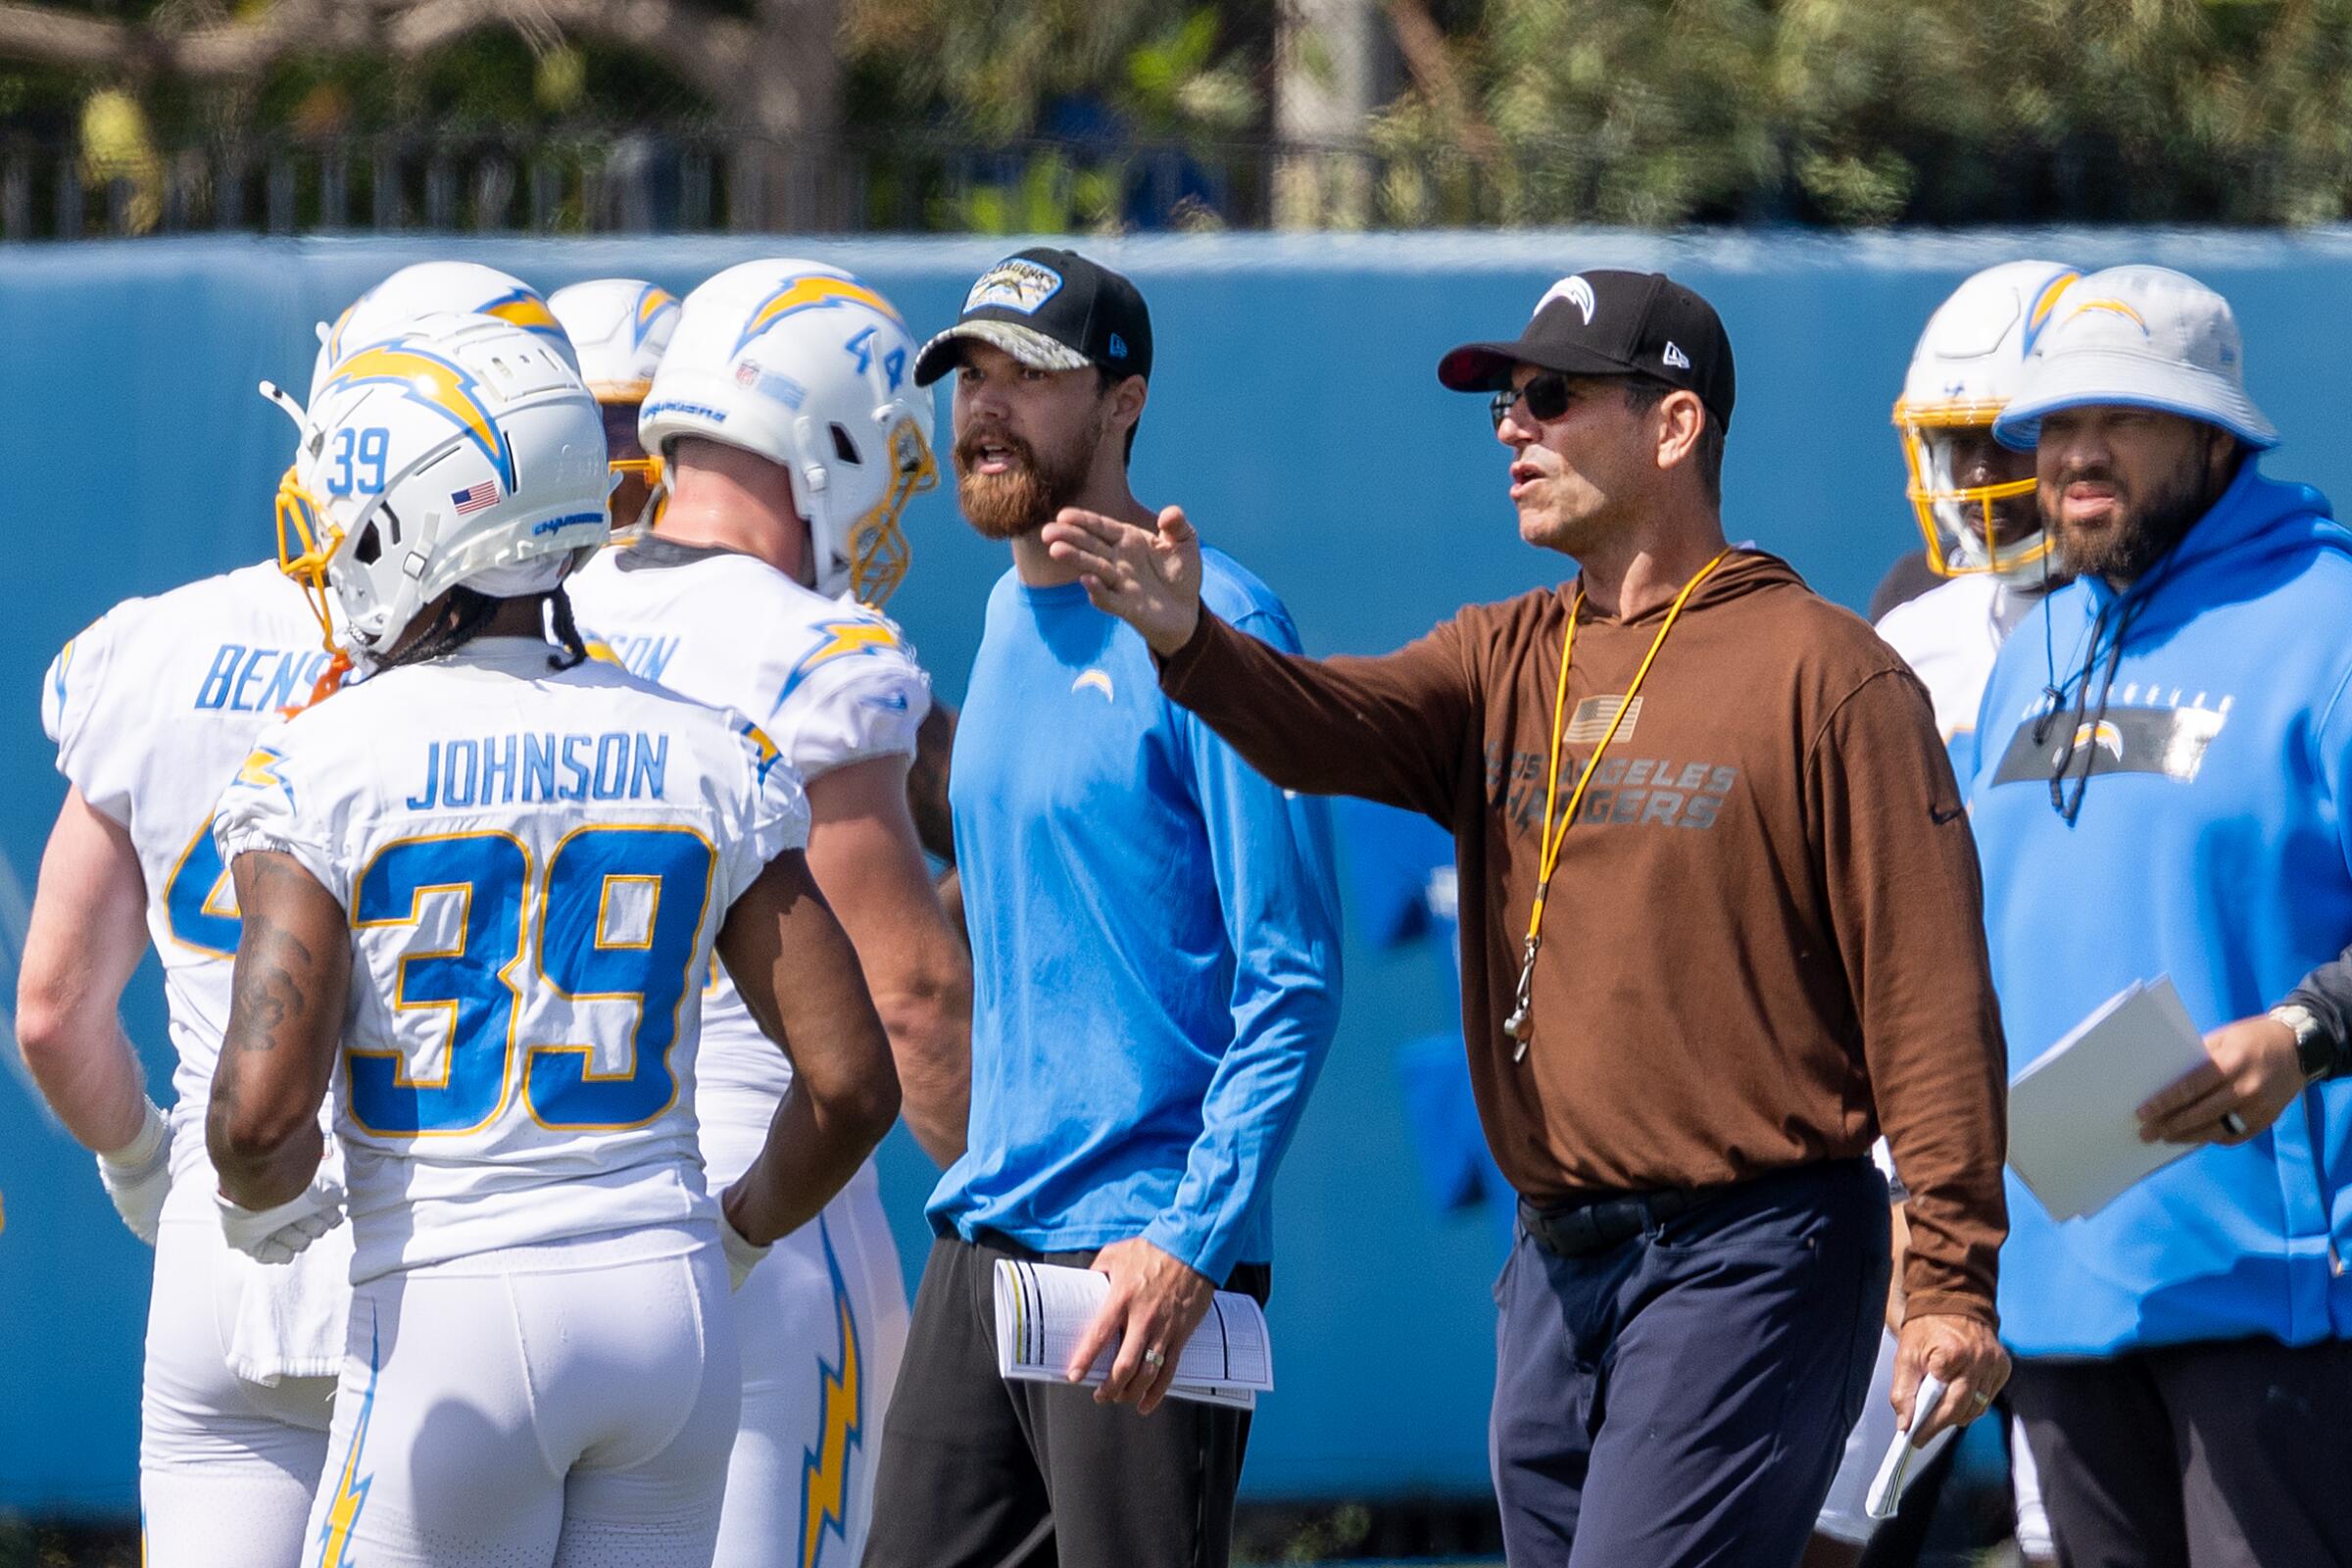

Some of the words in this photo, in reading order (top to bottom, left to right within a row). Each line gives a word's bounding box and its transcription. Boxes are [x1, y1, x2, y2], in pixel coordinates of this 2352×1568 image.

[845, 323, 906, 394] 44
[326, 427, 390, 497] 39
[406, 731, 668, 810] JOHNSON
[346, 823, 717, 1138] 39
